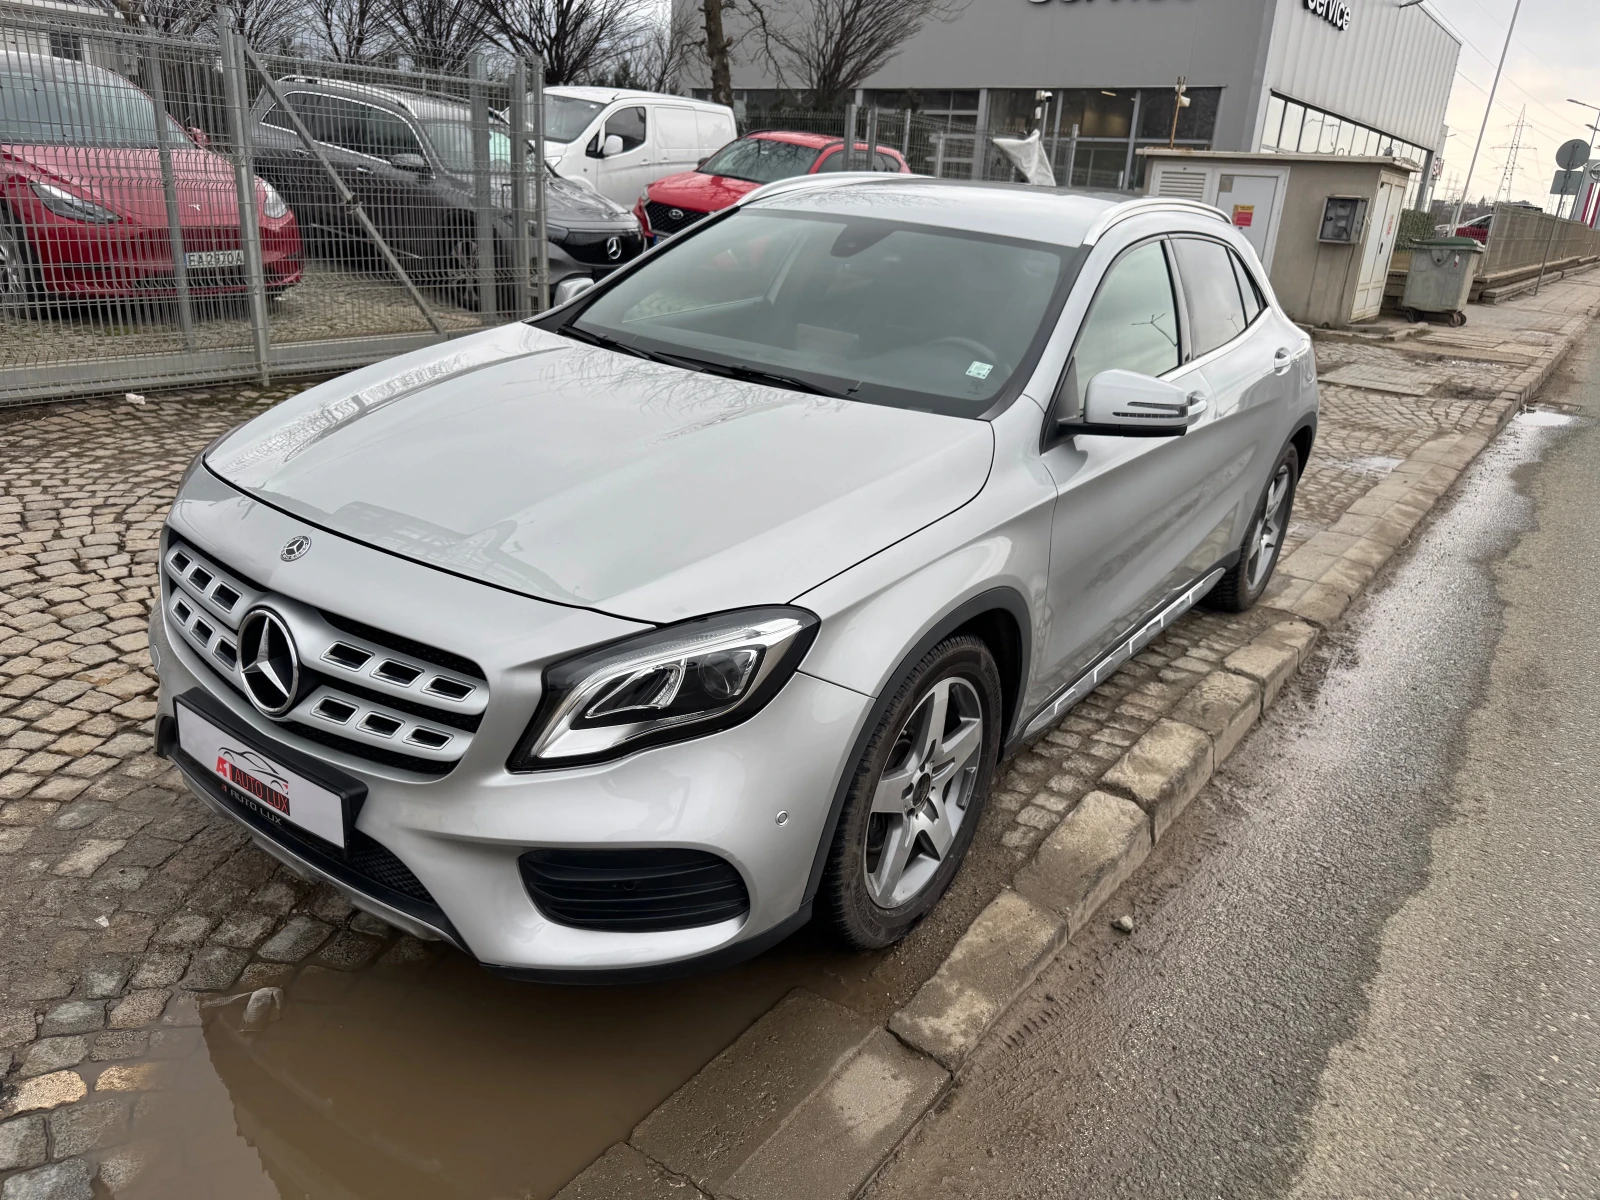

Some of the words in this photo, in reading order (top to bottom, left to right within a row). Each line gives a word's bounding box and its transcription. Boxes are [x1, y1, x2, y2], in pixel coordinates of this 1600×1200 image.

[216, 755, 233, 781] A1
[234, 768, 263, 799] AUTO
[266, 786, 289, 815] LUX
[230, 789, 257, 811] AUTO
[260, 807, 282, 826] LUX
